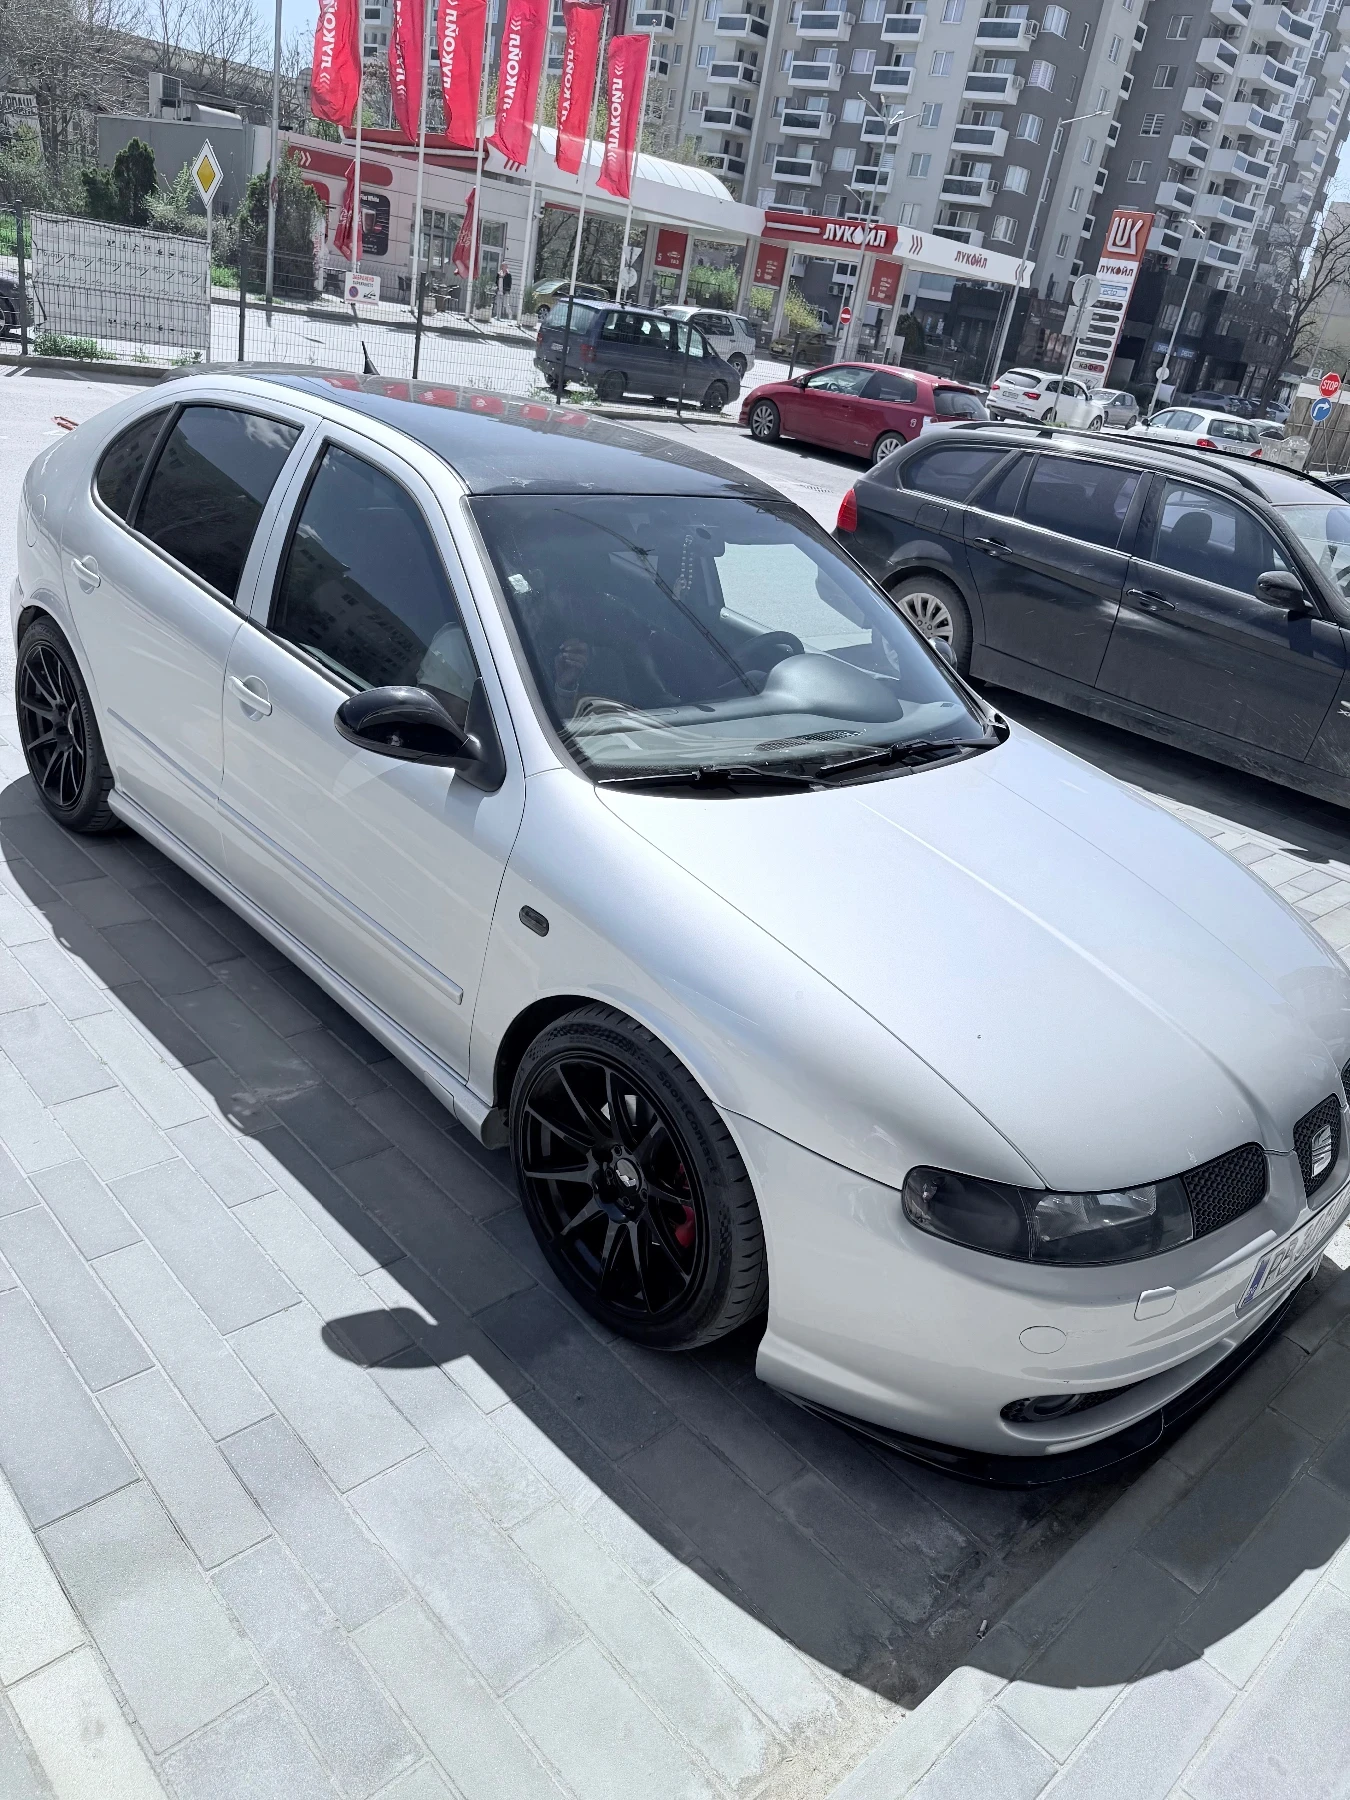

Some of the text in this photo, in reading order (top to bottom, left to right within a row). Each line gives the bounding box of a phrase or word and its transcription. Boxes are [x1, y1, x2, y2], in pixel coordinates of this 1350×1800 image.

[823, 223, 887, 248] ЛУКОЙЛ
[954, 249, 988, 270] ЛУКОЙЛ
[756, 268, 762, 278] 3
[1098, 264, 1135, 278] ЛУКОЙЛ
[1078, 362, 1100, 372] кафе
[1321, 379, 1339, 391] STOP
[656, 1069, 718, 1174] SportContact
